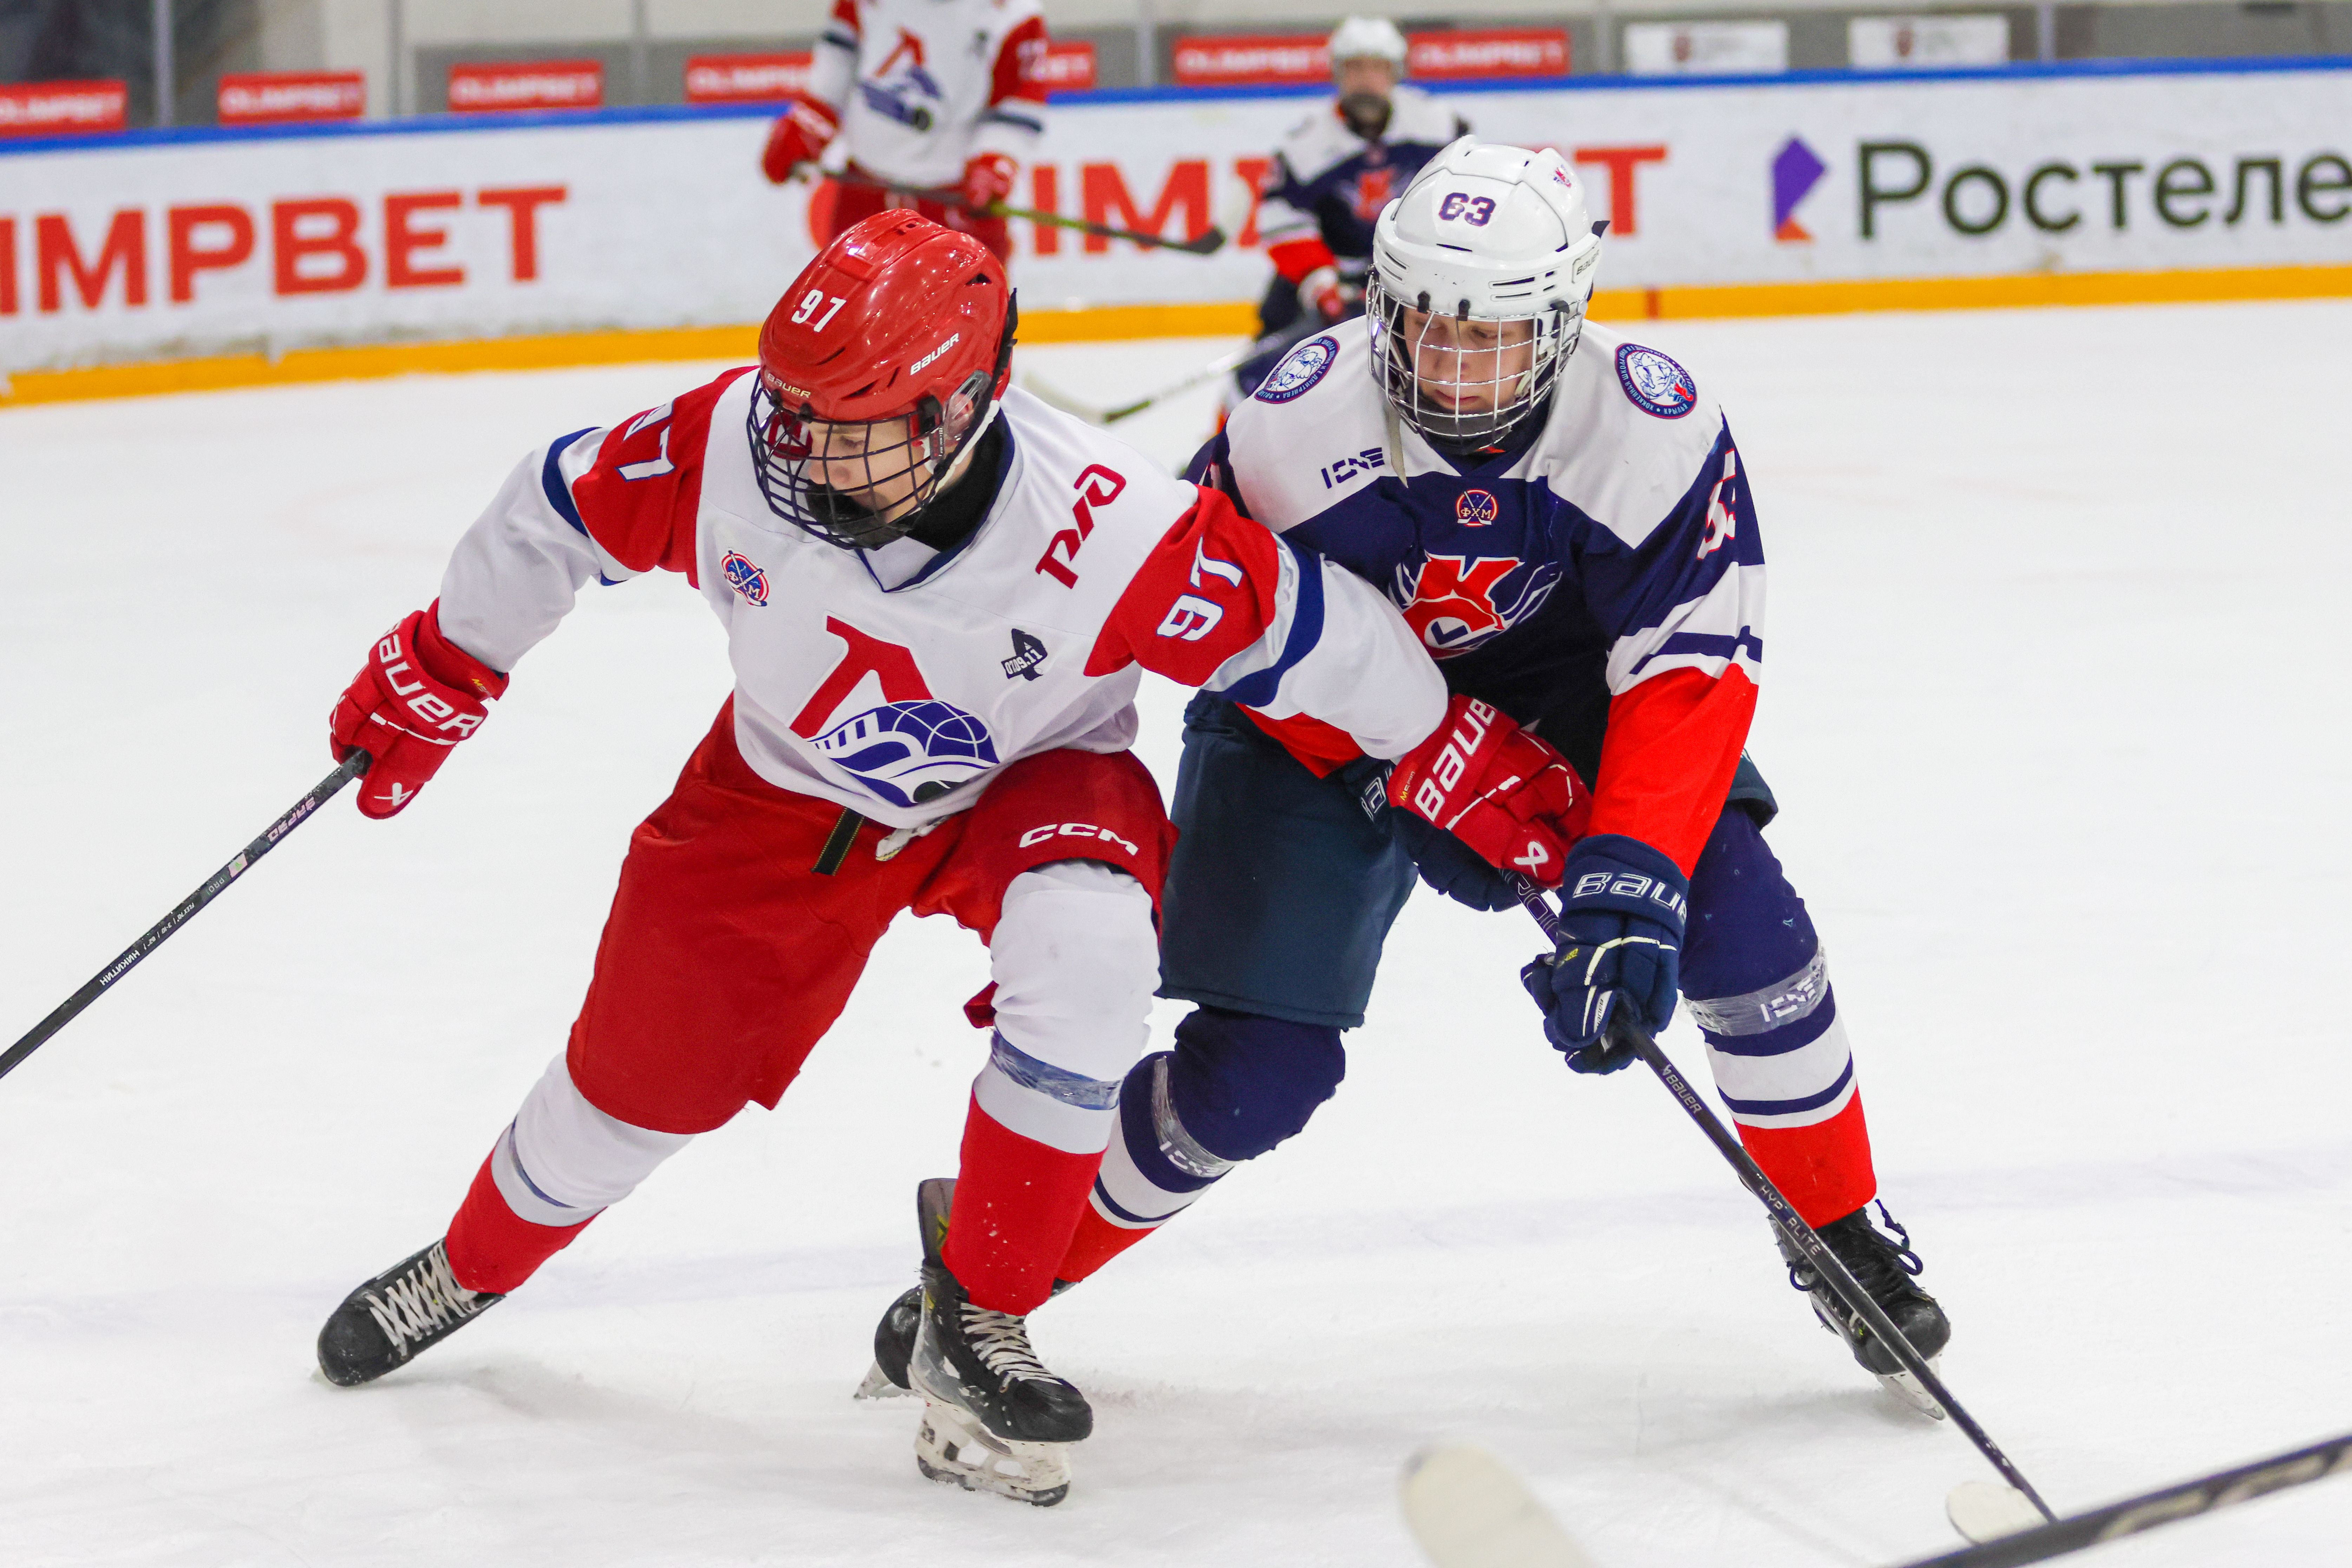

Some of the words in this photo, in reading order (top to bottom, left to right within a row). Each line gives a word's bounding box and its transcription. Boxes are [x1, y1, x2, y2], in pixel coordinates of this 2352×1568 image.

[1439, 192, 1496, 227] 63
[1858, 139, 2352, 242] Ростеле
[791, 289, 846, 332] 97
[910, 333, 959, 375] BAUER
[767, 373, 811, 398] BAUER
[1460, 507, 1492, 519] ФХМ
[1156, 534, 1243, 641] 97
[1415, 698, 1497, 822] BAUE
[1019, 823, 1139, 856] CCM
[207, 877, 225, 893] PRO
[99, 949, 140, 986] НИКИТИН
[1665, 1073, 1702, 1114] BAUER
